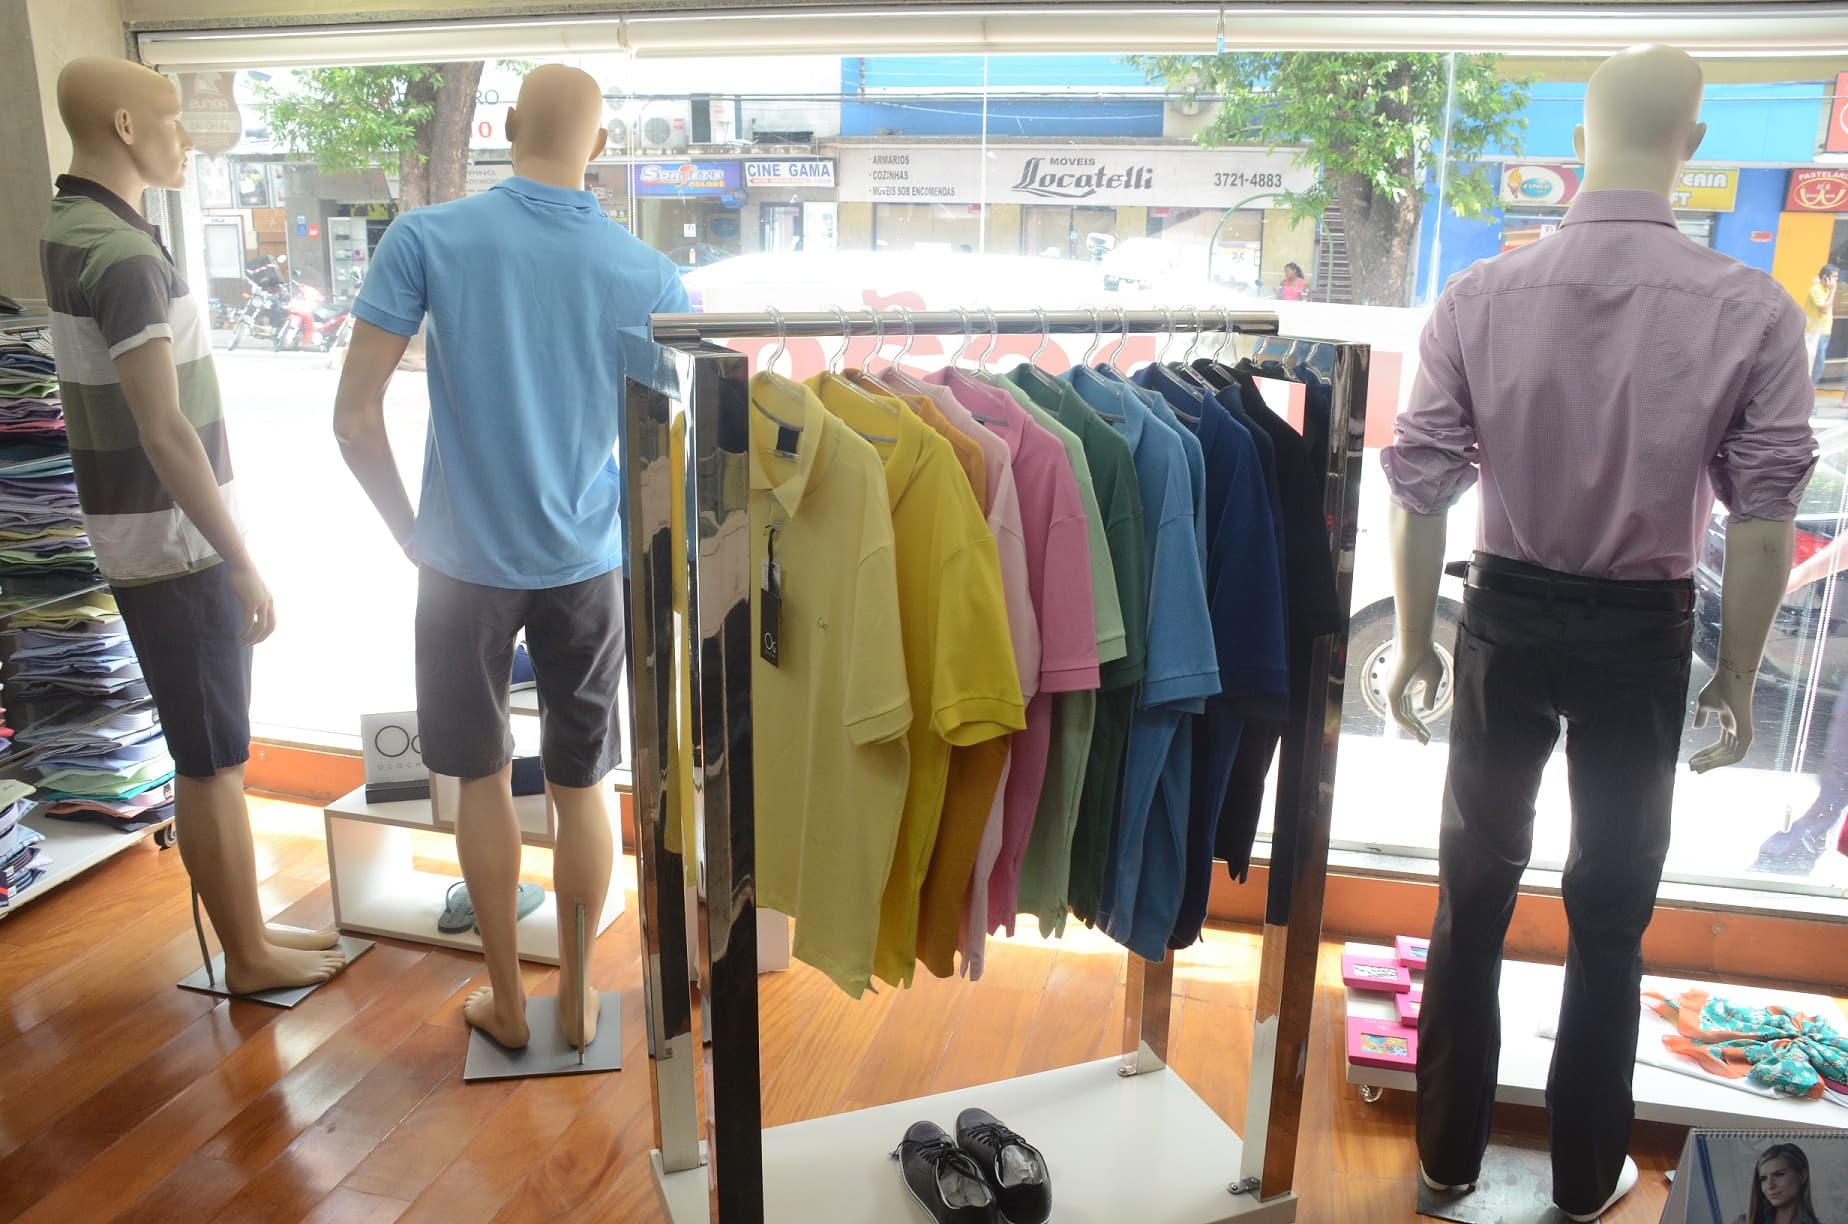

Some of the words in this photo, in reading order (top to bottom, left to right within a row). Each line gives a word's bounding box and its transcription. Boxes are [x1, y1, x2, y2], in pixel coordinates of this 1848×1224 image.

[747, 164, 781, 177] CINE
[788, 164, 830, 177] GAMA
[872, 170, 909, 180] COZINHAS
[1012, 157, 1153, 191] Locatelli
[1214, 172, 1282, 188] 3721-4883
[897, 186, 910, 196] SOB
[911, 186, 955, 197] ENCOMENDAS
